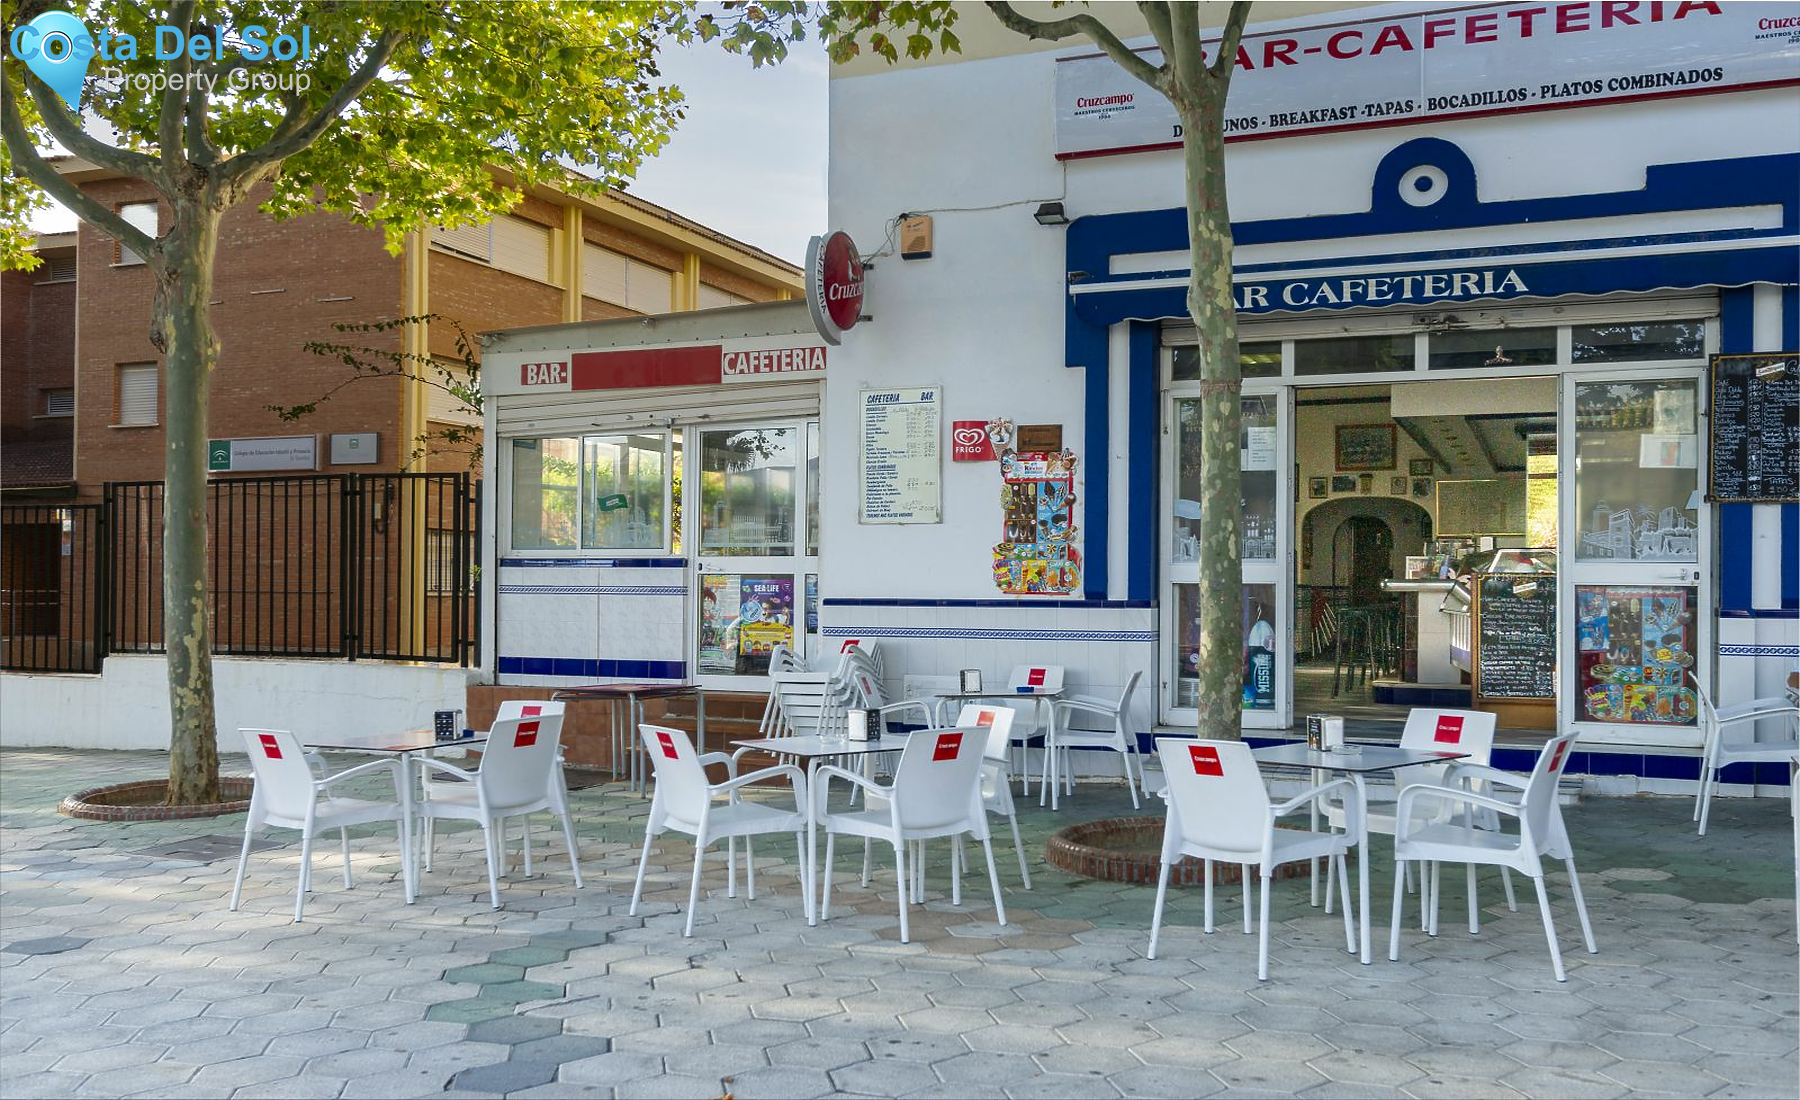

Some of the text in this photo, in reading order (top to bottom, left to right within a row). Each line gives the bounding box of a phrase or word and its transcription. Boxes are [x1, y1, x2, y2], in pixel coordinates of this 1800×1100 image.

[1077, 93, 1134, 107] Cruzcampo
[1269, 106, 1358, 128] BREAKFAST
[1427, 87, 1527, 112] BOCADILLOS
[1540, 79, 1603, 99] PLATOS
[1607, 67, 1723, 92] COMBINADOS
[1282, 269, 1529, 307] CAFETERIA
[722, 347, 826, 375] CAFETERIA
[866, 391, 934, 404] CAFETERIA BAR
[767, 584, 780, 592] LIFE
